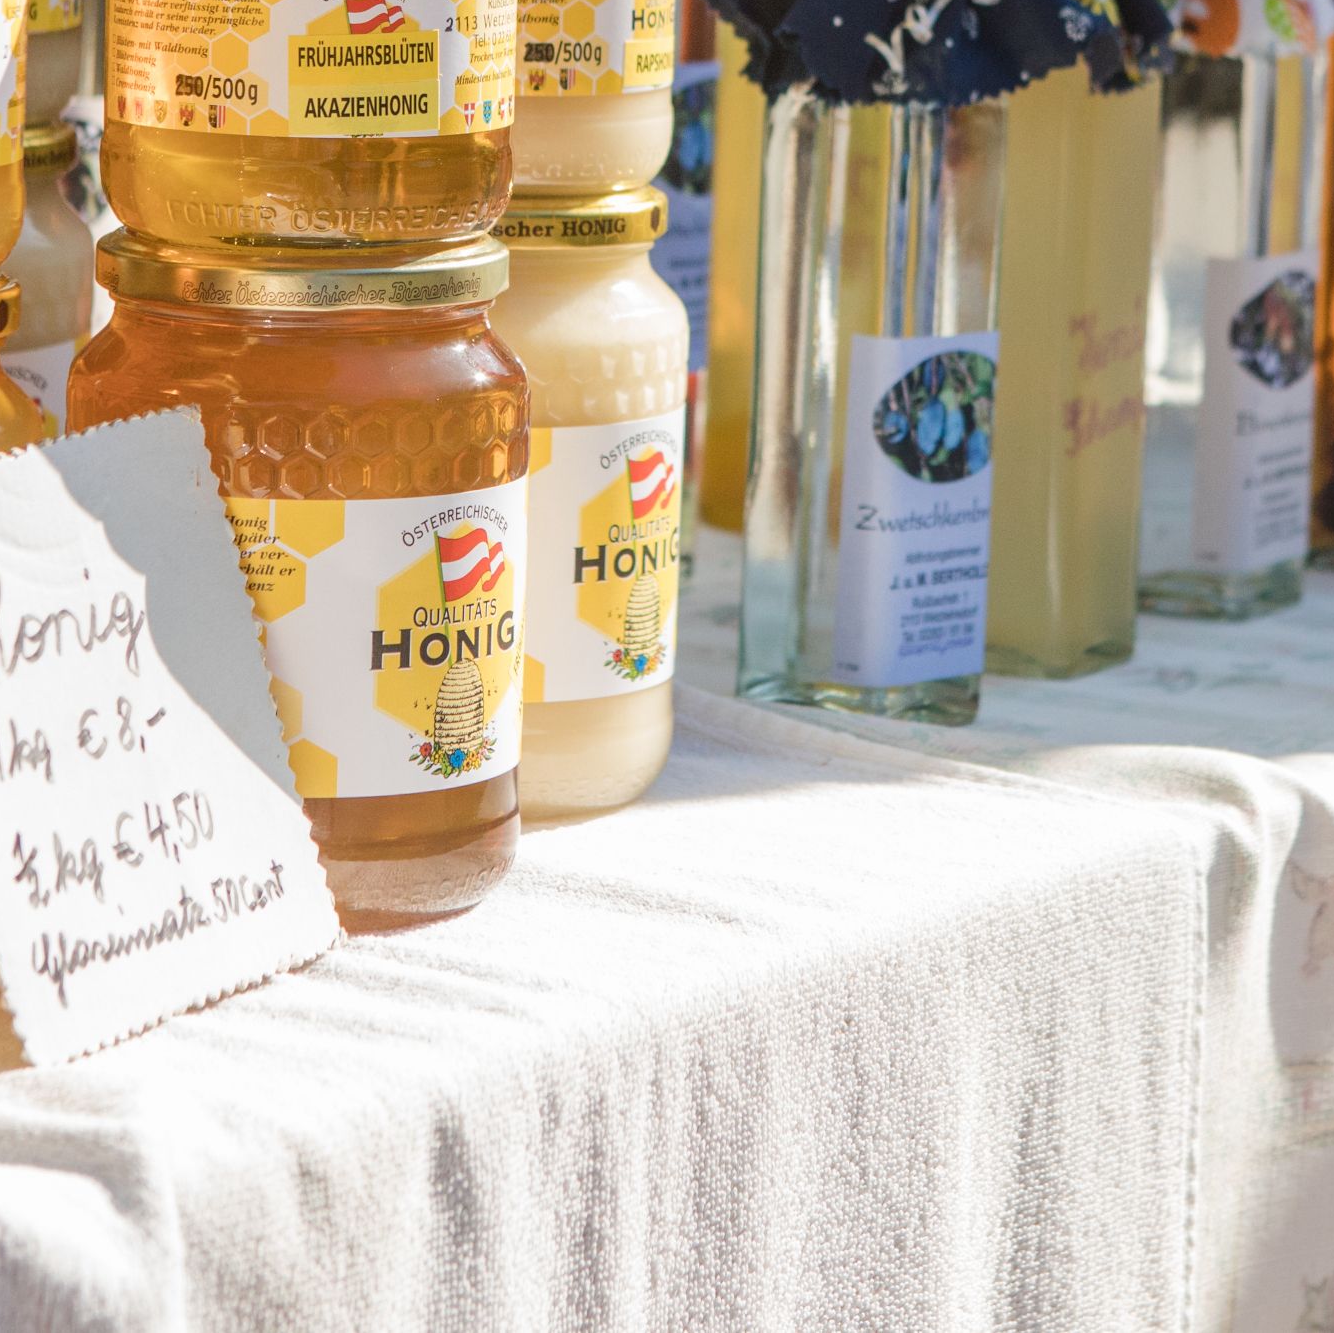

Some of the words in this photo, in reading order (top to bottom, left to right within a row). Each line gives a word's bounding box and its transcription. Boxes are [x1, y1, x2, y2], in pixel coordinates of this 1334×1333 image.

[166, 13, 189, 22] seine
[191, 15, 265, 27] ursprüngliche
[169, 1, 220, 15] verflüssigt
[222, 5, 264, 15] werden.
[182, 25, 216, 35] wieder.
[444, 15, 478, 33] 2113
[138, 40, 152, 50] mit
[297, 37, 435, 68] FRÜHJAHRSBLÜTEN
[303, 92, 429, 119] AKAZIENHONIG
[561, 217, 626, 238] HONIG
[181, 280, 232, 305] Echter
[235, 280, 386, 308] Österreichischer
[388, 272, 482, 304] Bienenhonig
[401, 504, 509, 548] ÖSTERREICHISCHER
[608, 516, 670, 544] QUALITÄTS
[260, 550, 289, 560] ver-
[572, 527, 680, 584] HONIG
[279, 566, 296, 576] er
[413, 597, 497, 629] QUALITÄTS
[369, 609, 516, 671] HONIG
